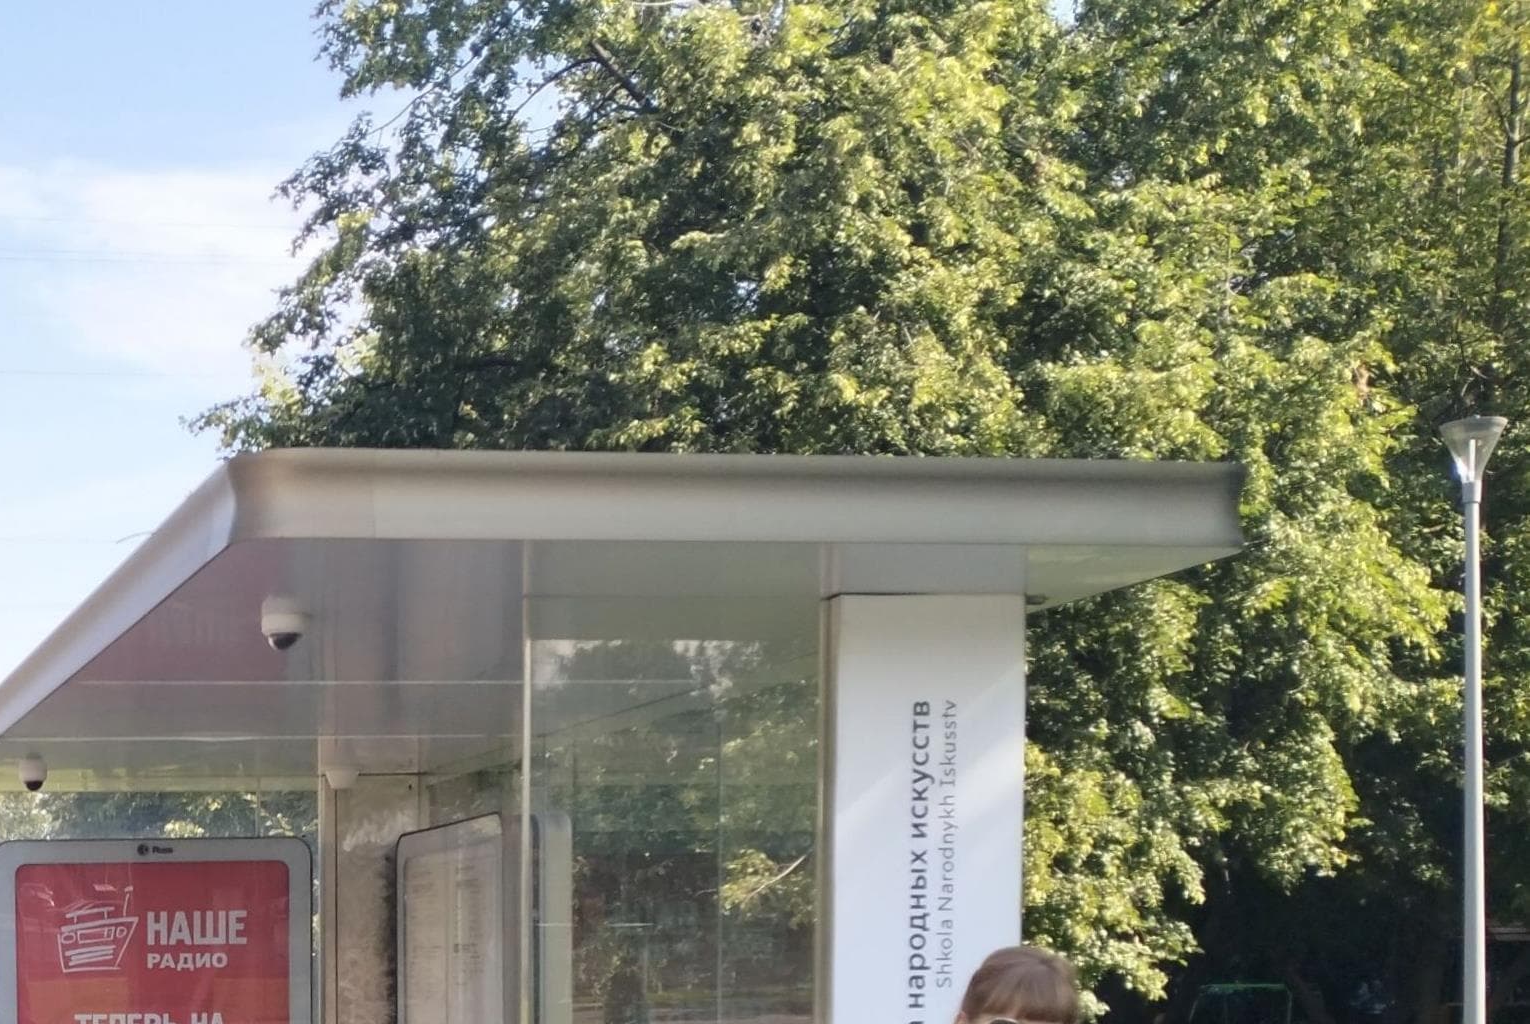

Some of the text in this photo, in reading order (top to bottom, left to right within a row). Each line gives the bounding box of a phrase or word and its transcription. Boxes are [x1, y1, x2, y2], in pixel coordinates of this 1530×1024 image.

[910, 700, 936, 839] искусств
[936, 699, 959, 988] Shkola Narodnykh Iskusstv
[146, 910, 248, 946] НАШЕ
[146, 952, 229, 971] РАДИО
[907, 850, 931, 1008] народных
